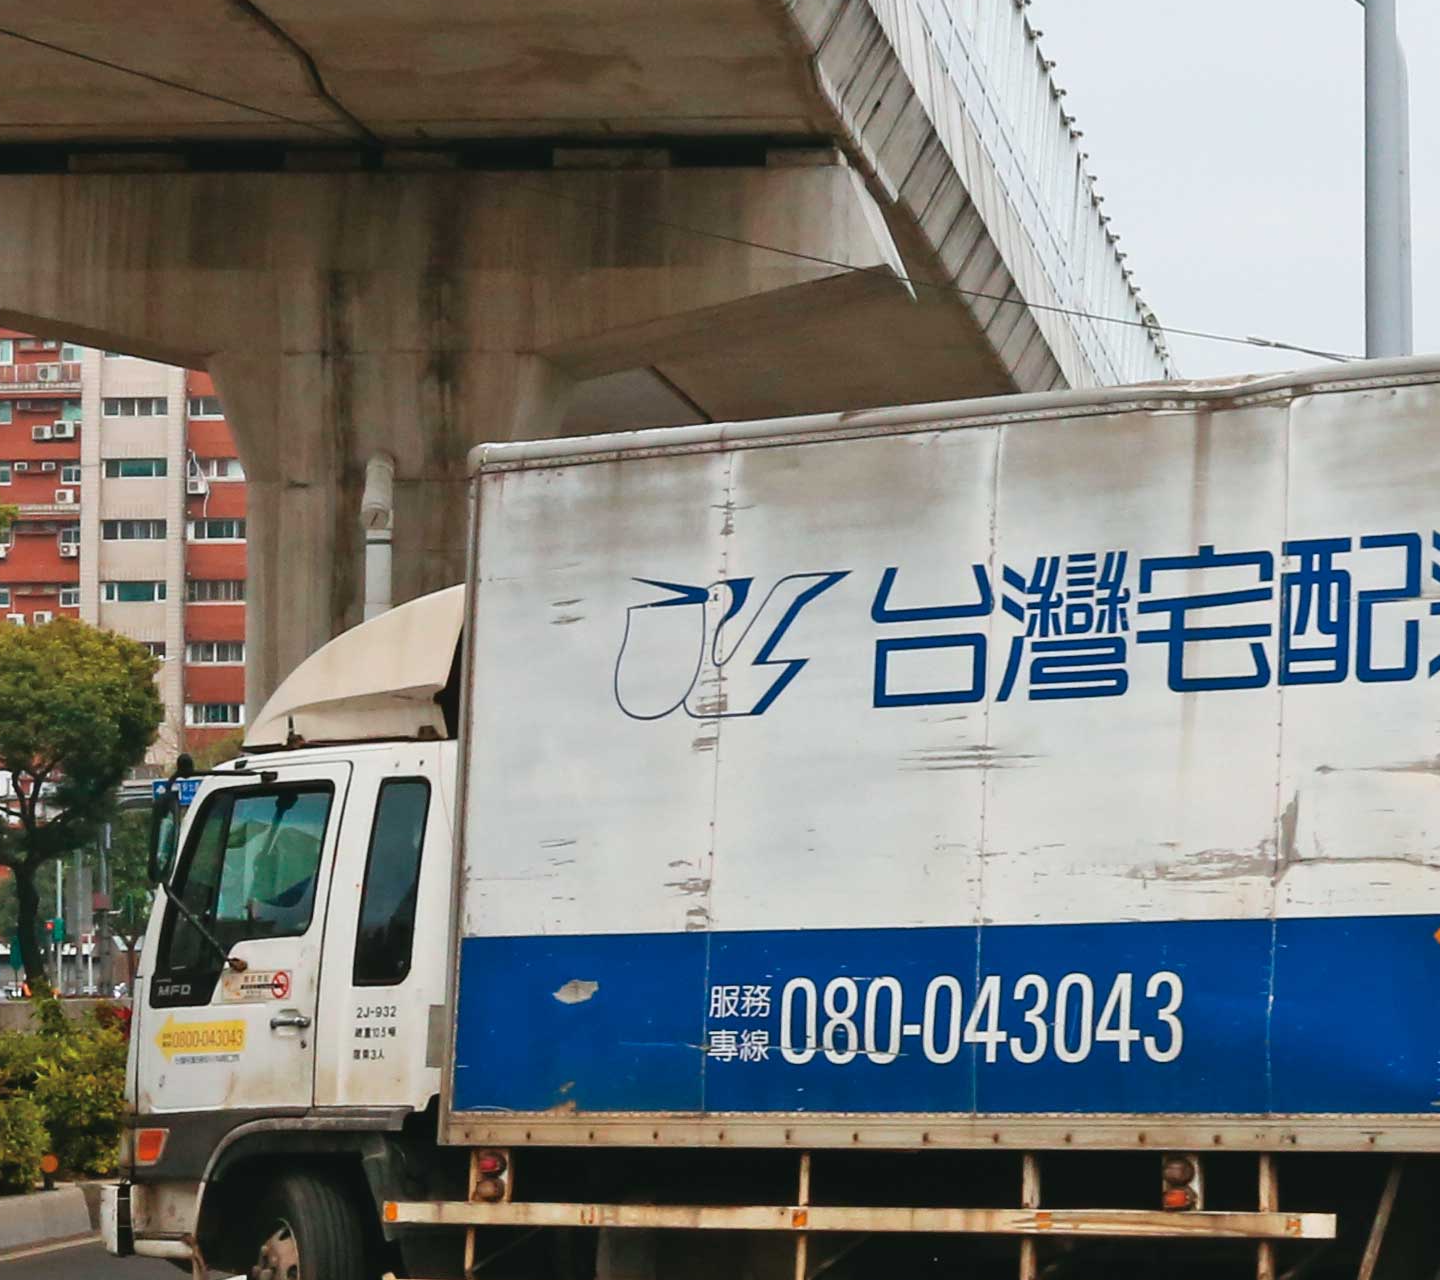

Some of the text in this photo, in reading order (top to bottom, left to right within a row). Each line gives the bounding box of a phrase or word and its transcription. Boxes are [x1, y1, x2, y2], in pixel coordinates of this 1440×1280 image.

[356, 1006, 397, 1018] 2J-932
[709, 985, 772, 1019] 服務
[780, 970, 1184, 1065] 080-043043
[707, 1029, 770, 1062] 專線
